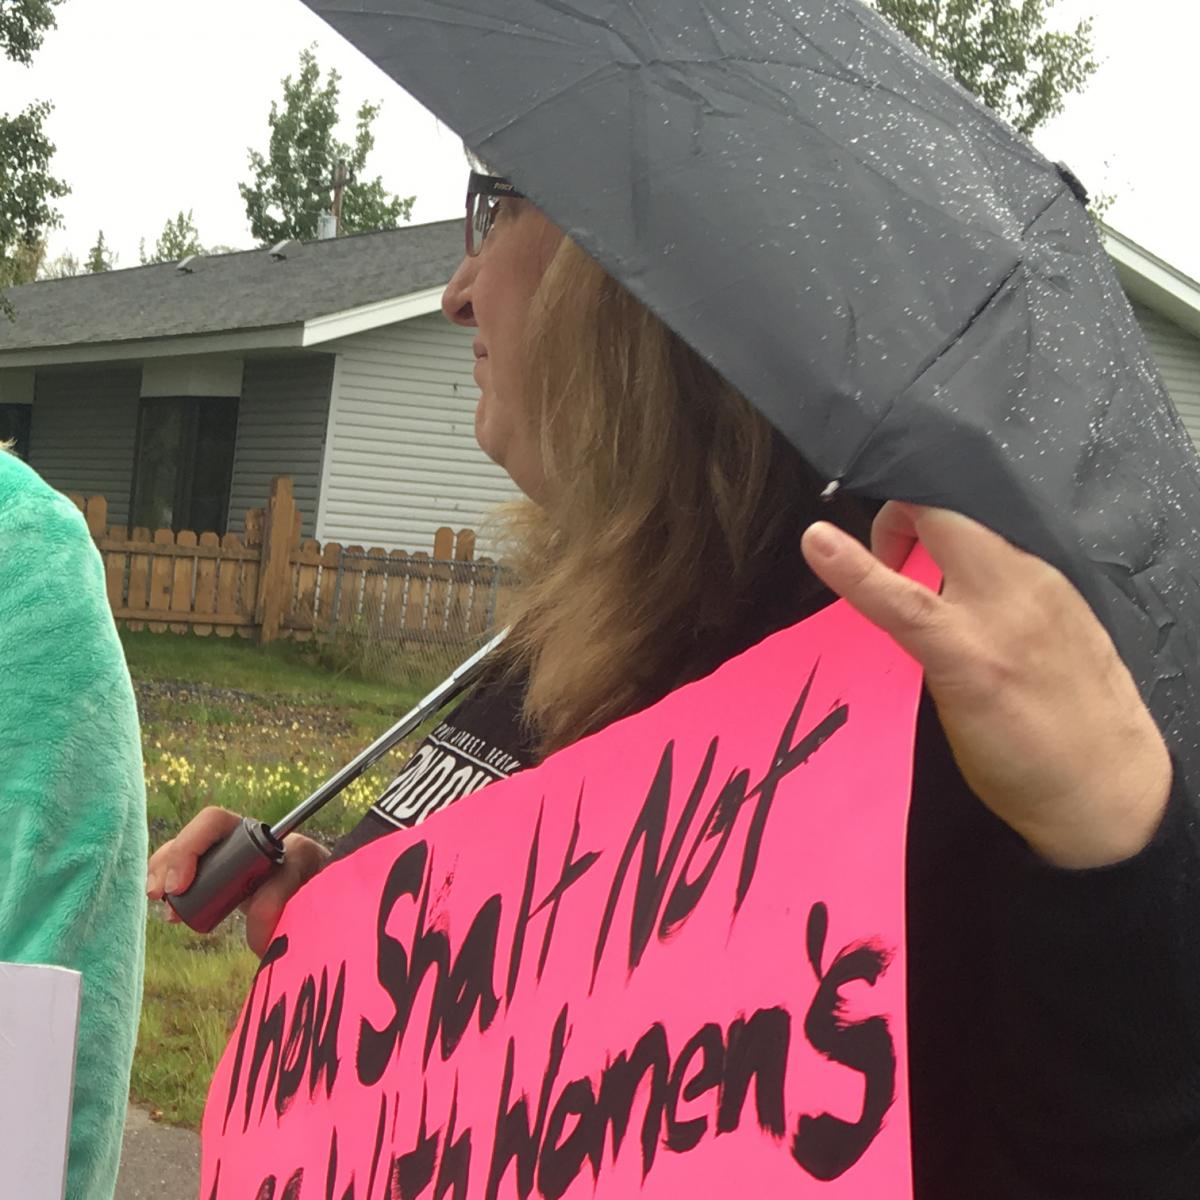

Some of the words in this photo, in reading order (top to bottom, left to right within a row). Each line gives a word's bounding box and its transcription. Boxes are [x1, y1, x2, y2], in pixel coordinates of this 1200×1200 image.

[222, 934, 347, 1136] Thou
[356, 776, 603, 1087] Shalt
[587, 656, 849, 998] Not
